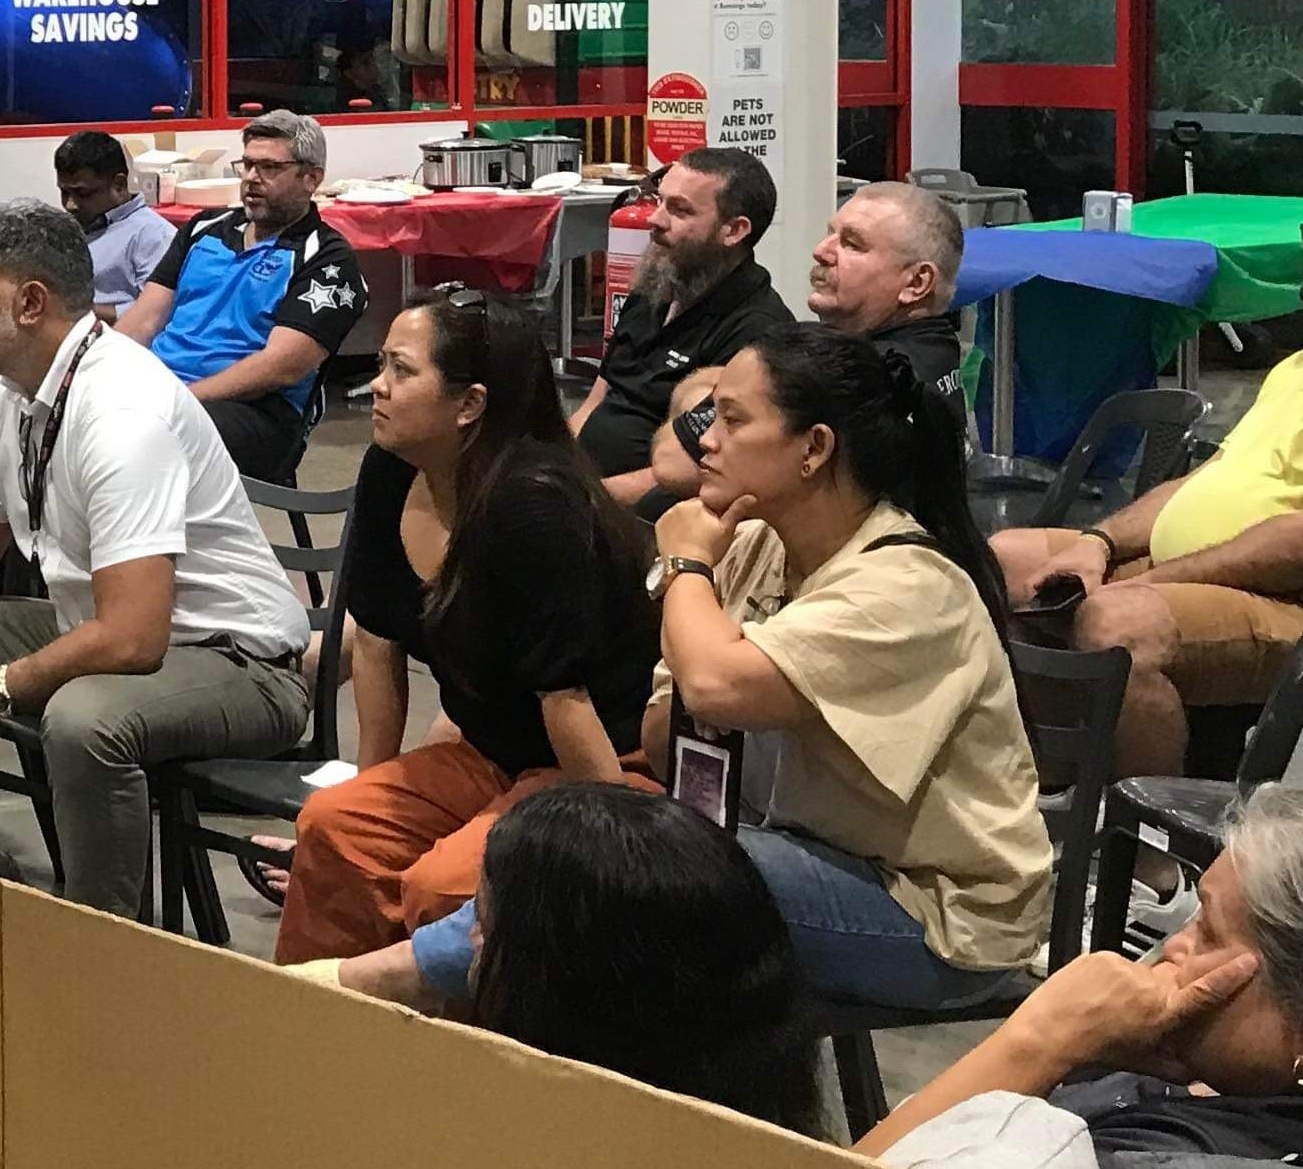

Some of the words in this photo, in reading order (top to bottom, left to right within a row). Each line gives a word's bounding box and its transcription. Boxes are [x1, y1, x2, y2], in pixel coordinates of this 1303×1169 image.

[527, 1, 626, 31] DELIVERY
[30, 11, 139, 43] SAVINGS
[651, 100, 705, 115] POWDER
[733, 98, 763, 111] PETS
[722, 114, 745, 126] ARE
[749, 113, 774, 126] NOT
[719, 129, 776, 142] ALLOWED
